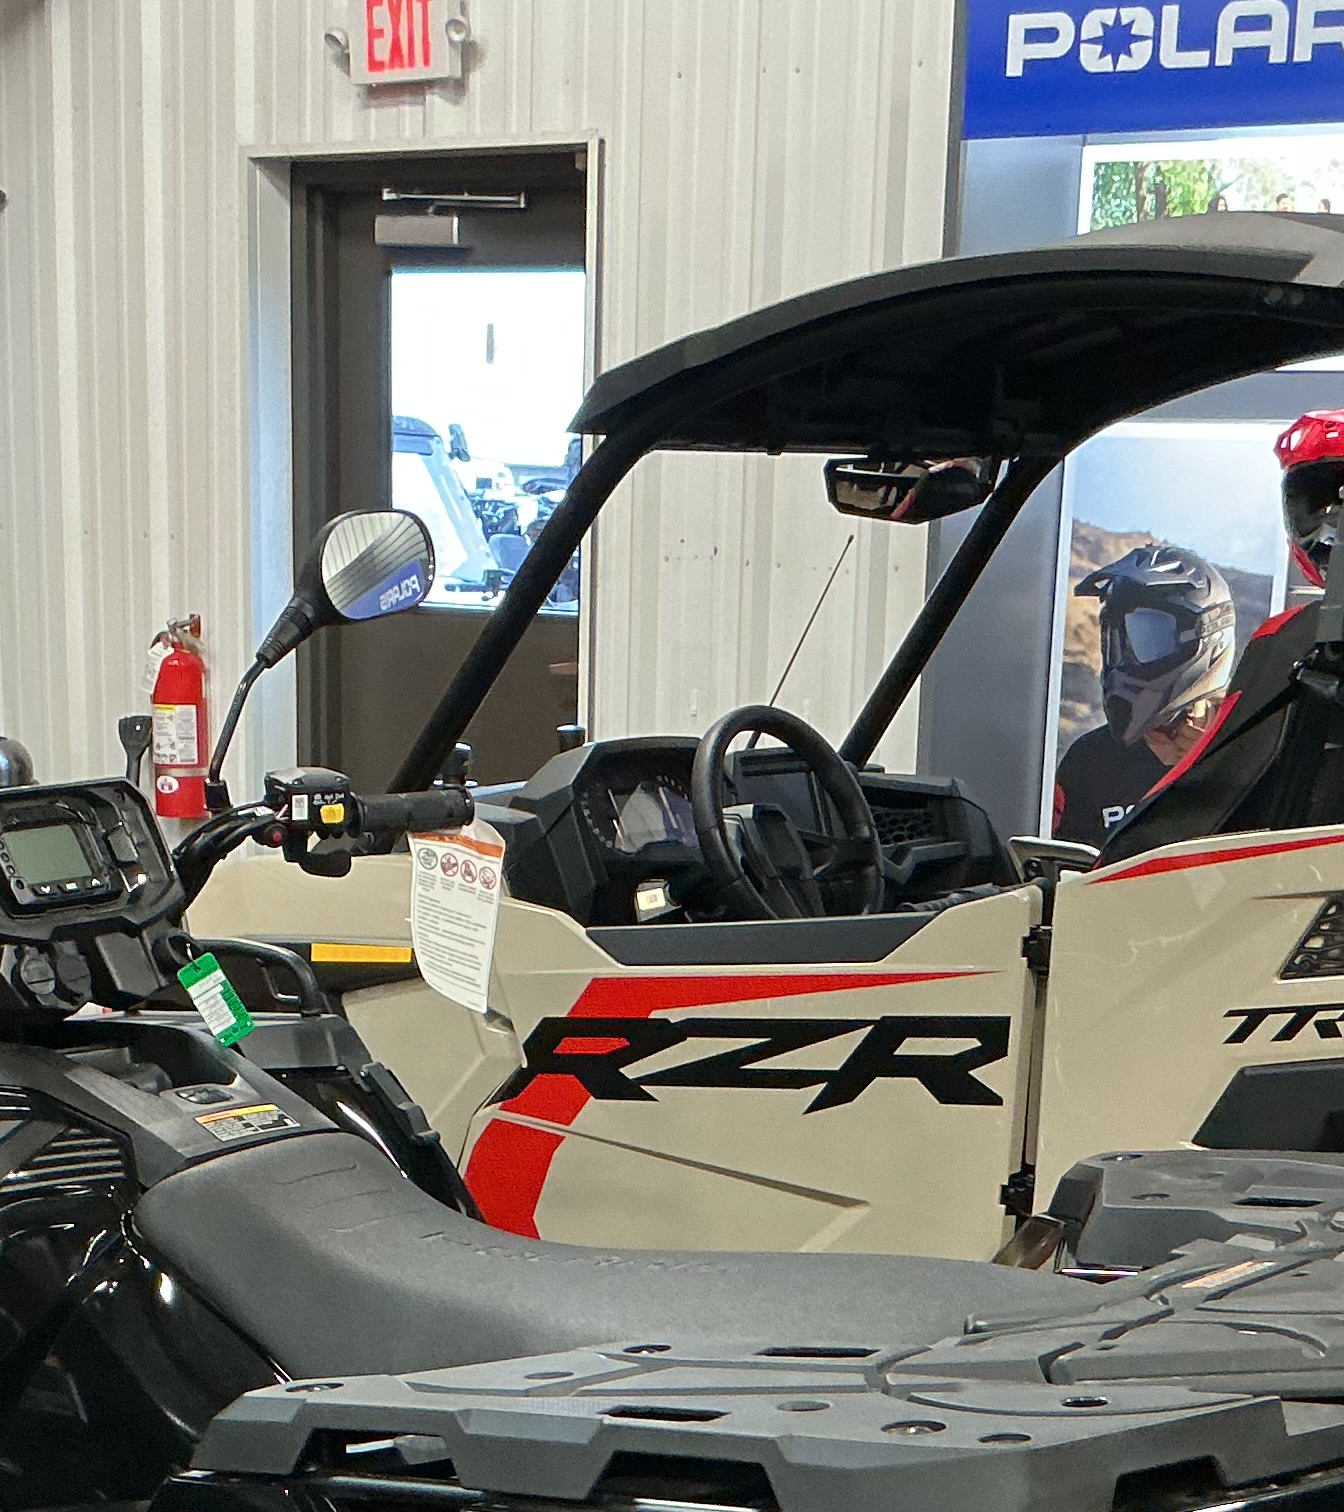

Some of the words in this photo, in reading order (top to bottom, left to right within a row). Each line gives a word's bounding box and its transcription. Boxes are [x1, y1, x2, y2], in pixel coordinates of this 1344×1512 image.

[366, 0, 432, 73] EXIT
[1102, 804, 1136, 829] P
[483, 1015, 1012, 1115] RZR
